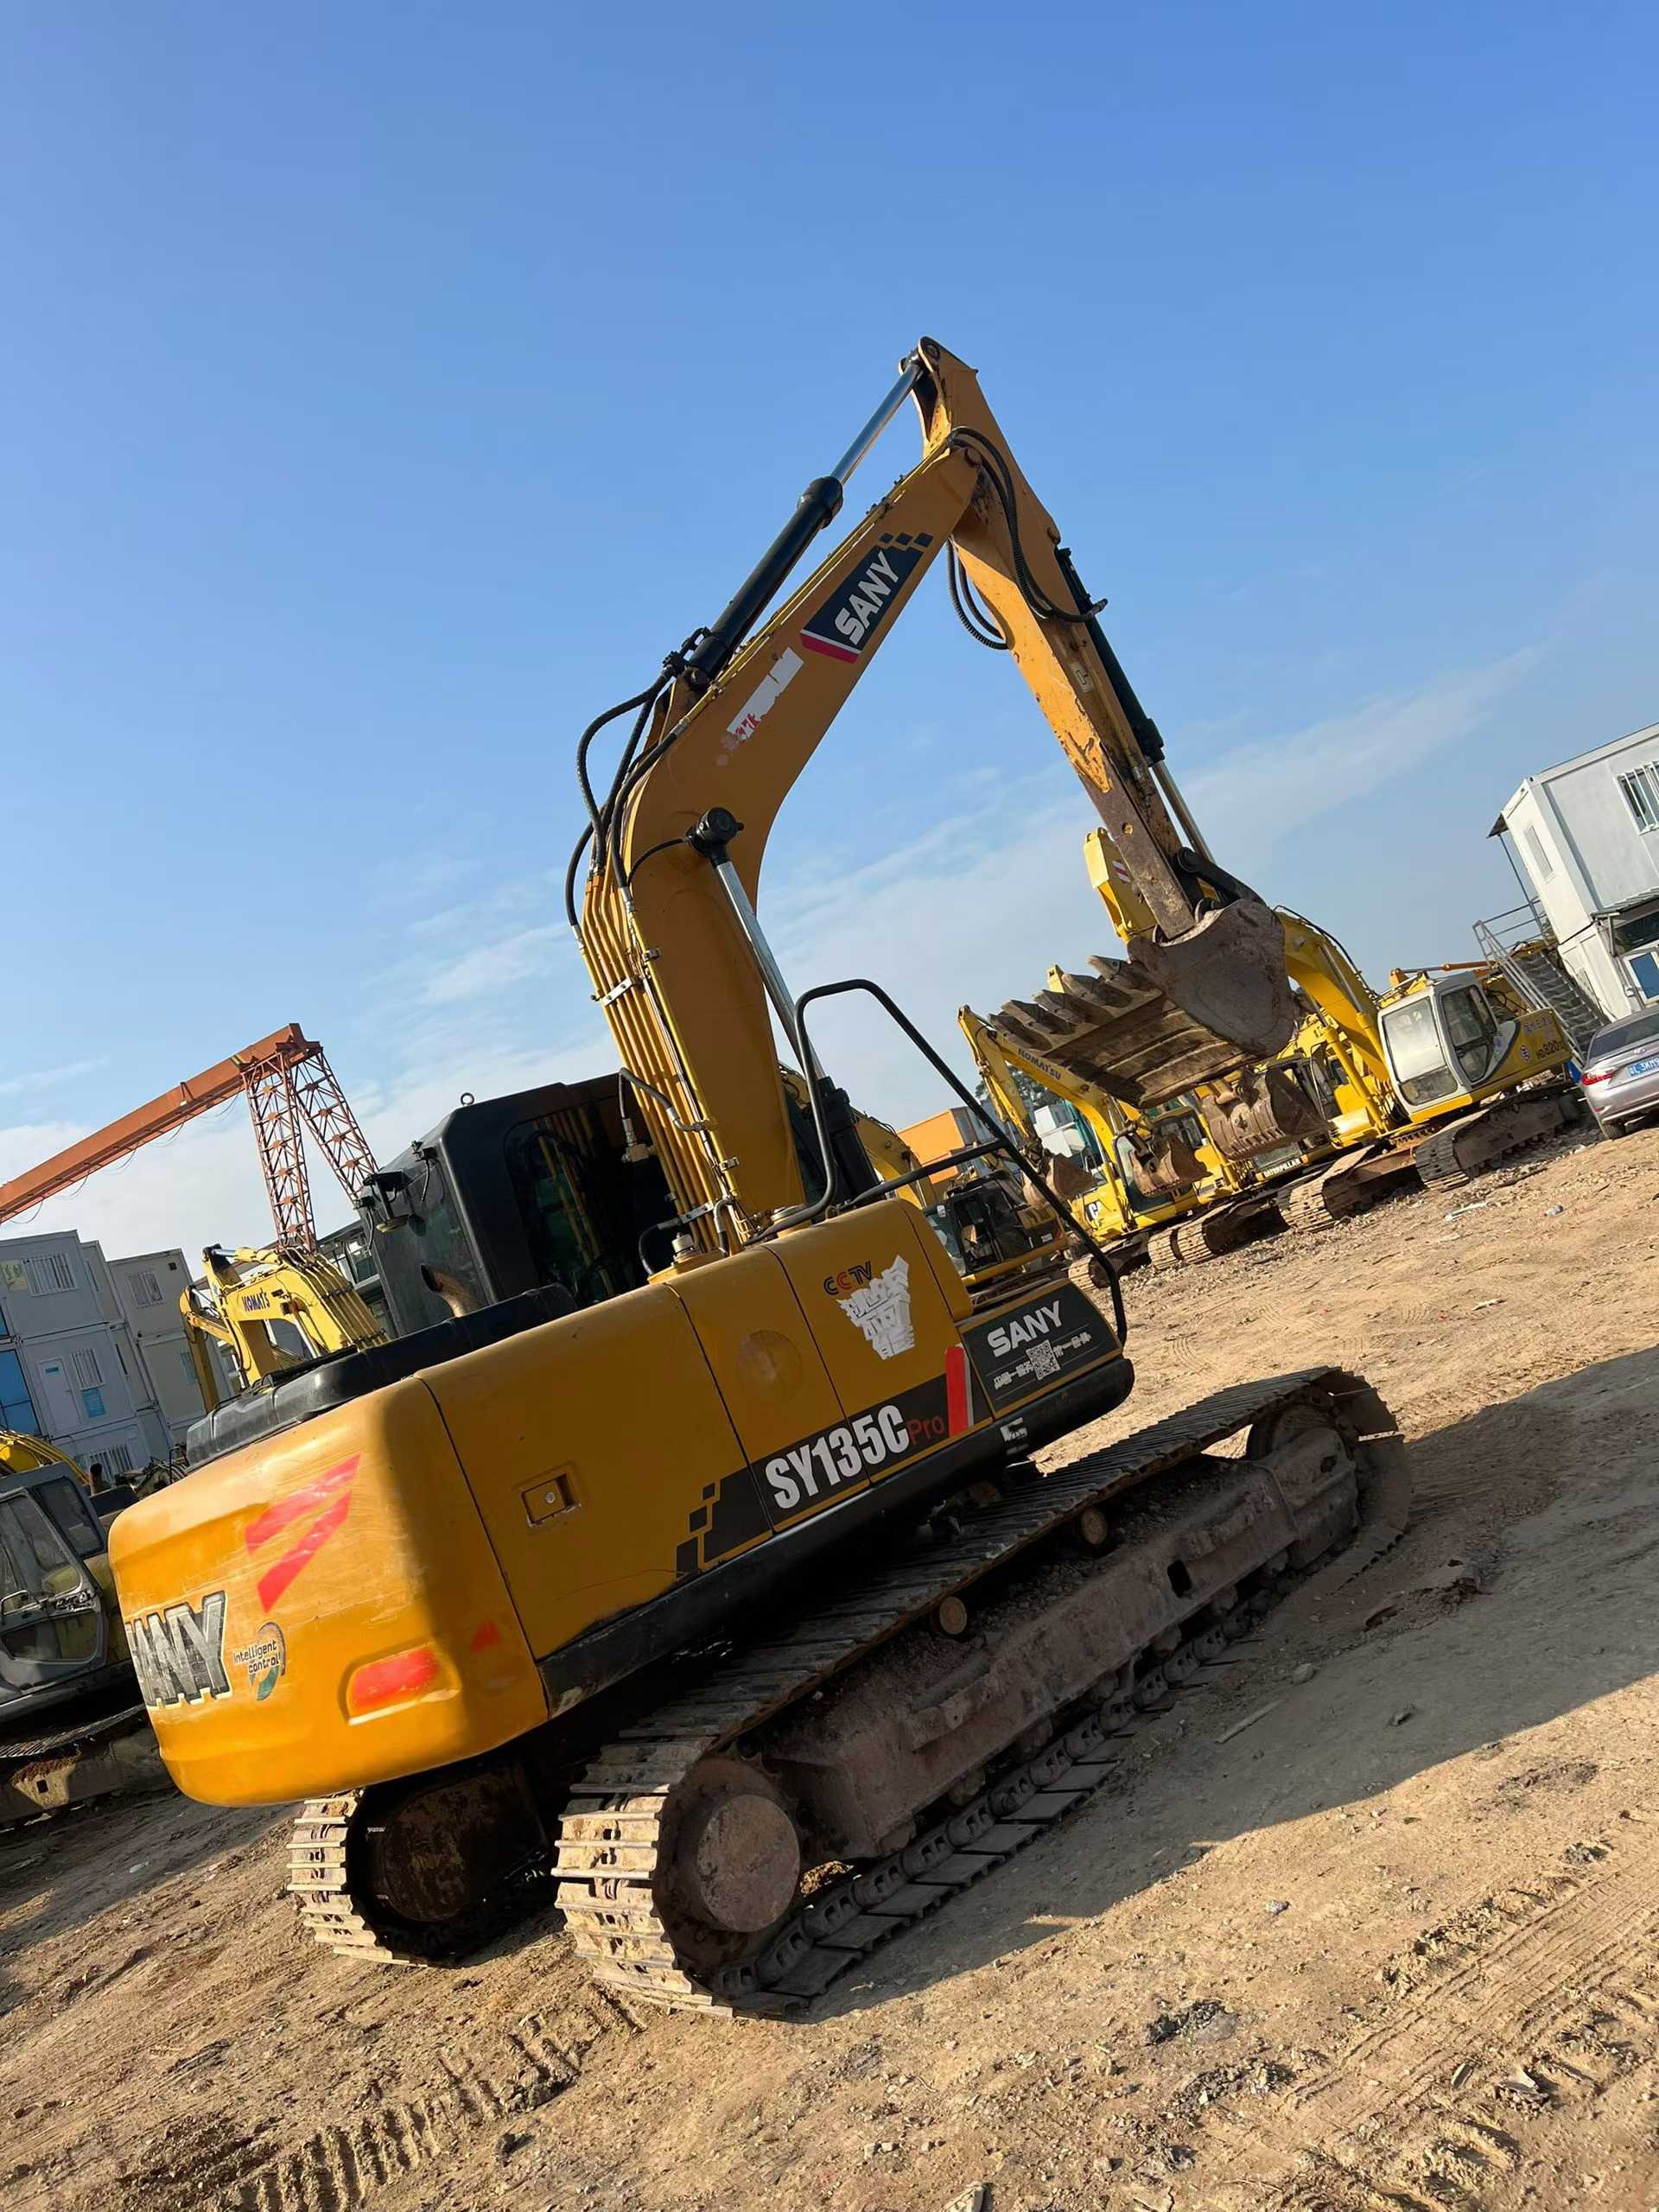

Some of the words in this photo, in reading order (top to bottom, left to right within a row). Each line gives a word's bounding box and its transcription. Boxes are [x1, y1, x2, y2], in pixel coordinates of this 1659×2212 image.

[835, 550, 899, 645] SANY
[1018, 1047, 1062, 1080] KOMATSU
[823, 1261, 872, 1295] CCTV
[987, 1300, 1065, 1357] SANY
[764, 1404, 910, 1510] SY135C
[907, 1415, 945, 1446] Pro
